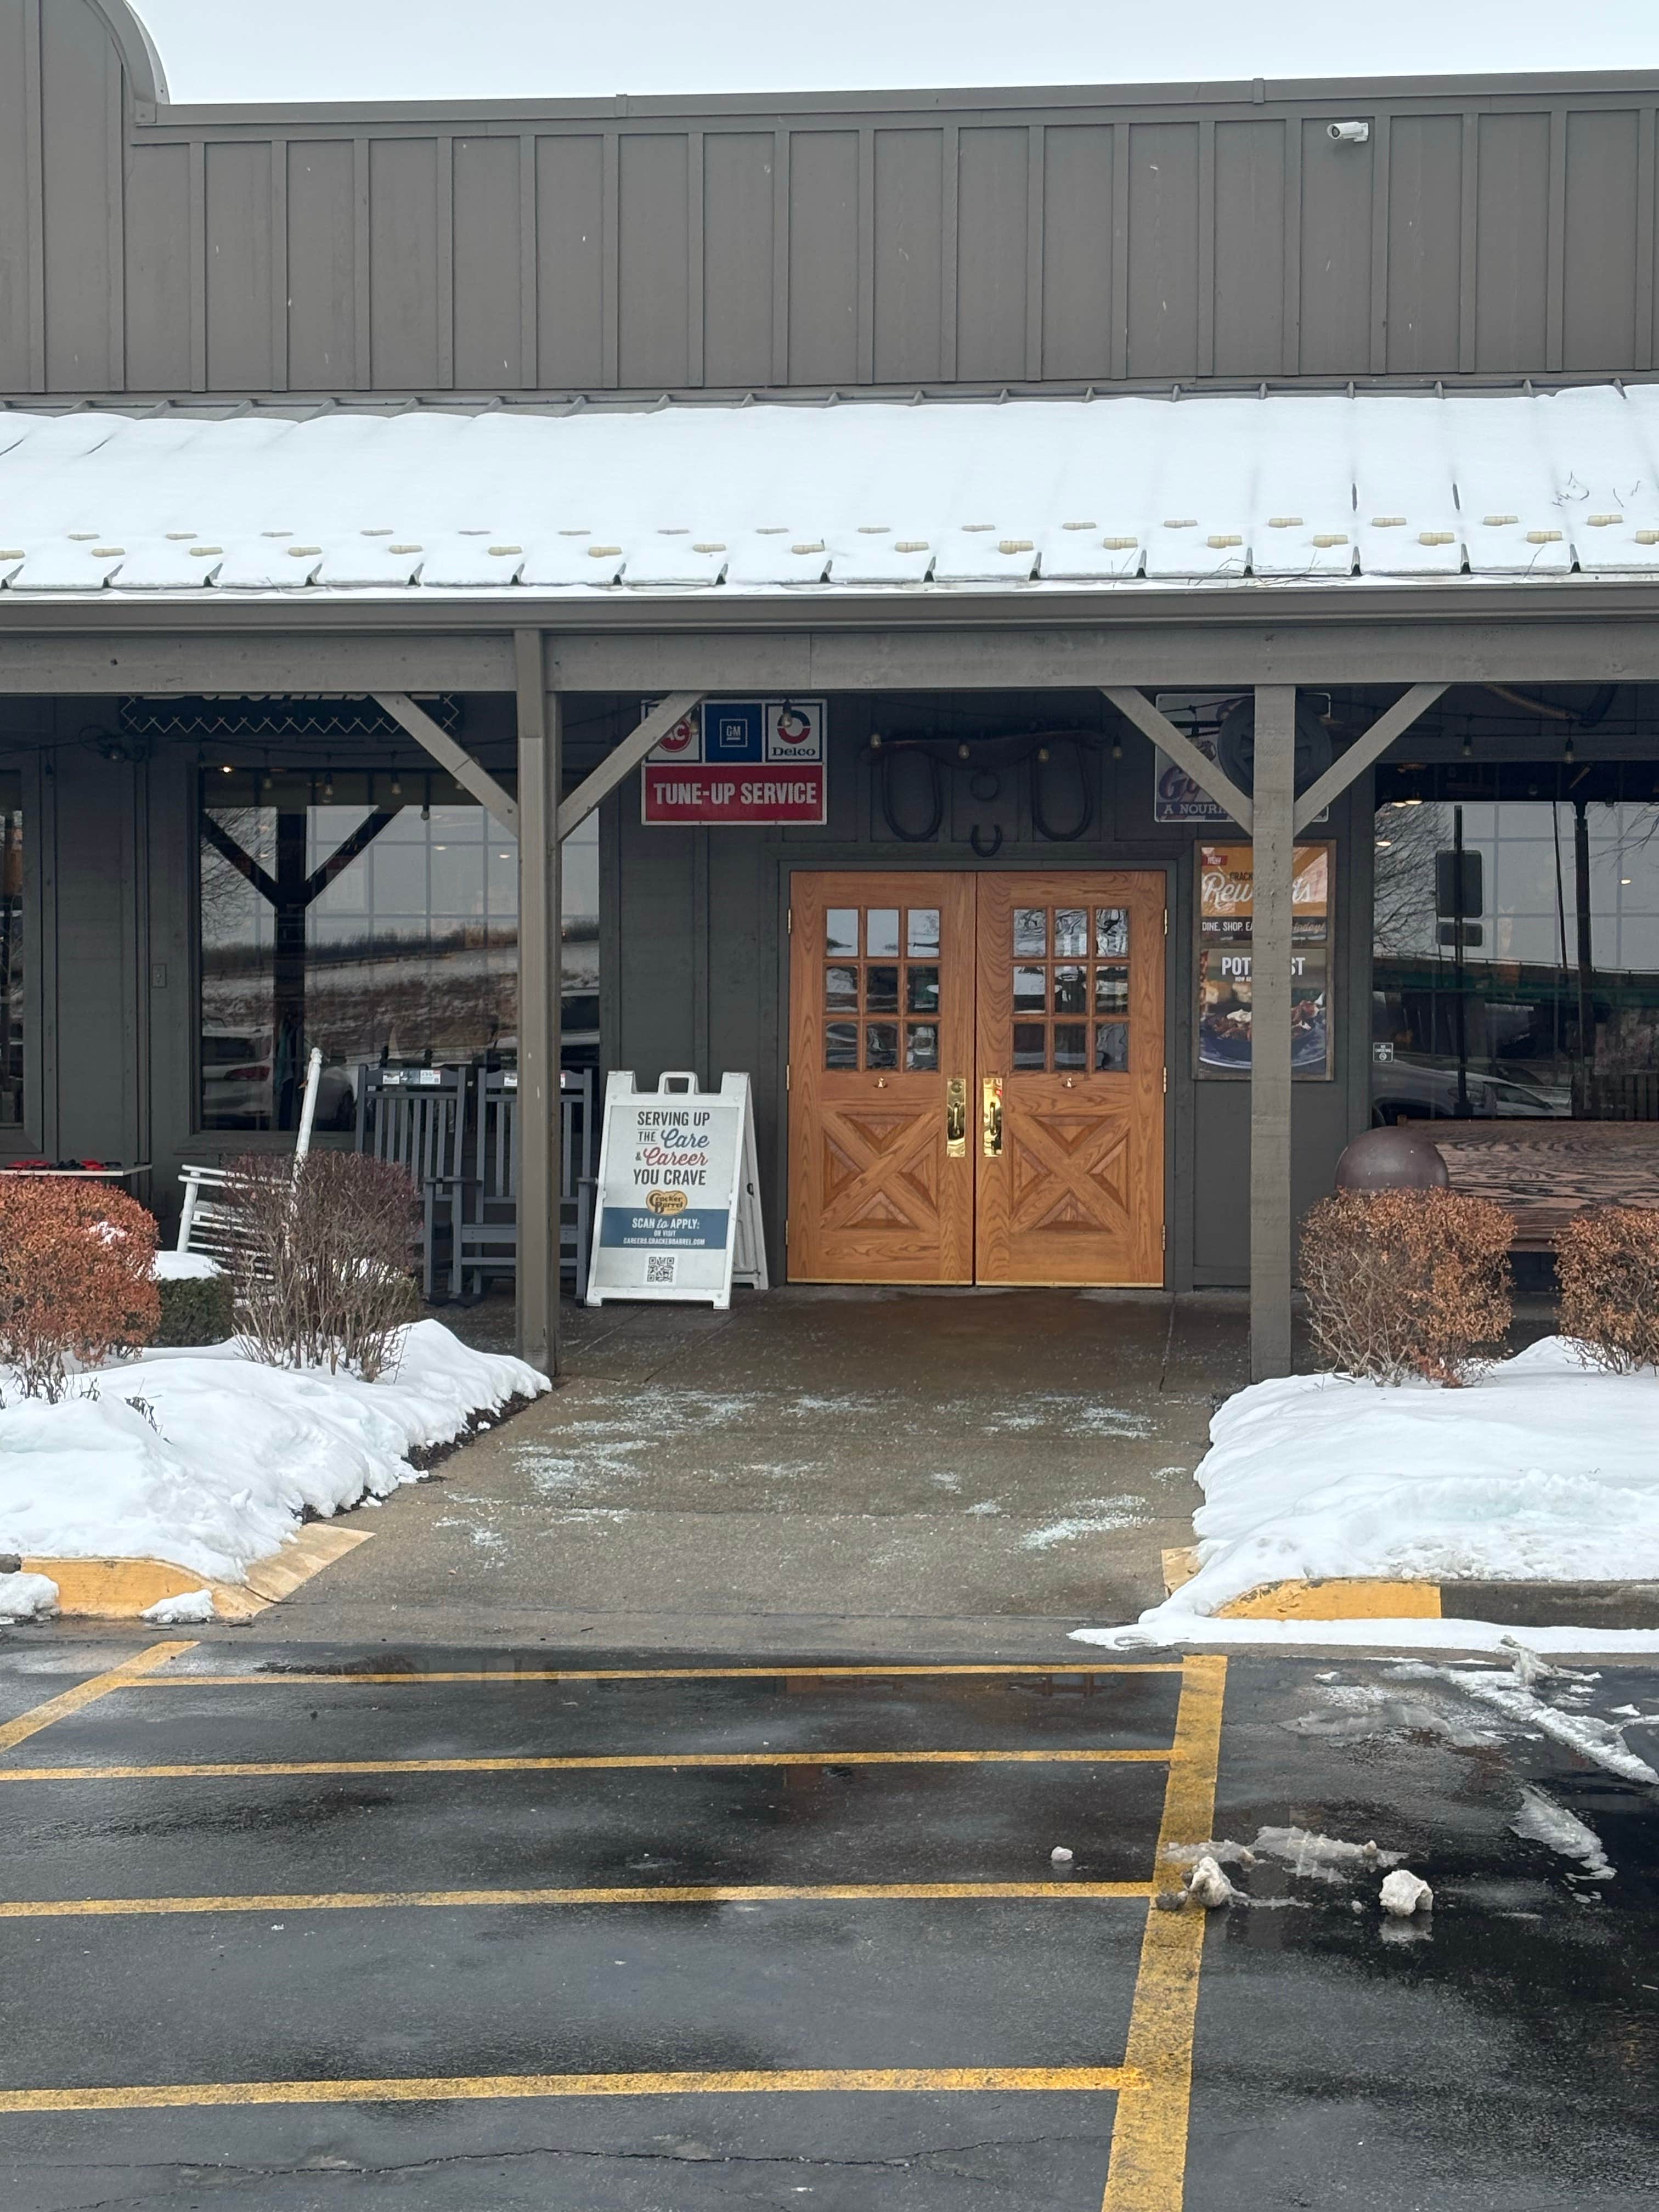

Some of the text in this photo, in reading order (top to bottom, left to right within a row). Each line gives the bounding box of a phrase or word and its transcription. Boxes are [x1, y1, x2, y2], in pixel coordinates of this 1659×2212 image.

[726, 725, 741, 736] GM
[772, 747, 815, 757] Delco
[653, 782, 817, 805] TUNE-UP SERVICE
[1164, 803, 1226, 814] A NOURI
[1229, 871, 1253, 881] CRACK
[1222, 922, 1243, 932] SHOP.
[1222, 957, 1251, 975] POT
[637, 1111, 710, 1126] SERVING UP
[638, 1128, 710, 1148] THE Care
[635, 1147, 708, 1166] & Career
[633, 1169, 707, 1186] YOU CRAVE
[649, 1193, 682, 1207] Cracker
[654, 1201, 683, 1214] Barrel
[632, 1217, 700, 1229] SCAN to APPLY:
